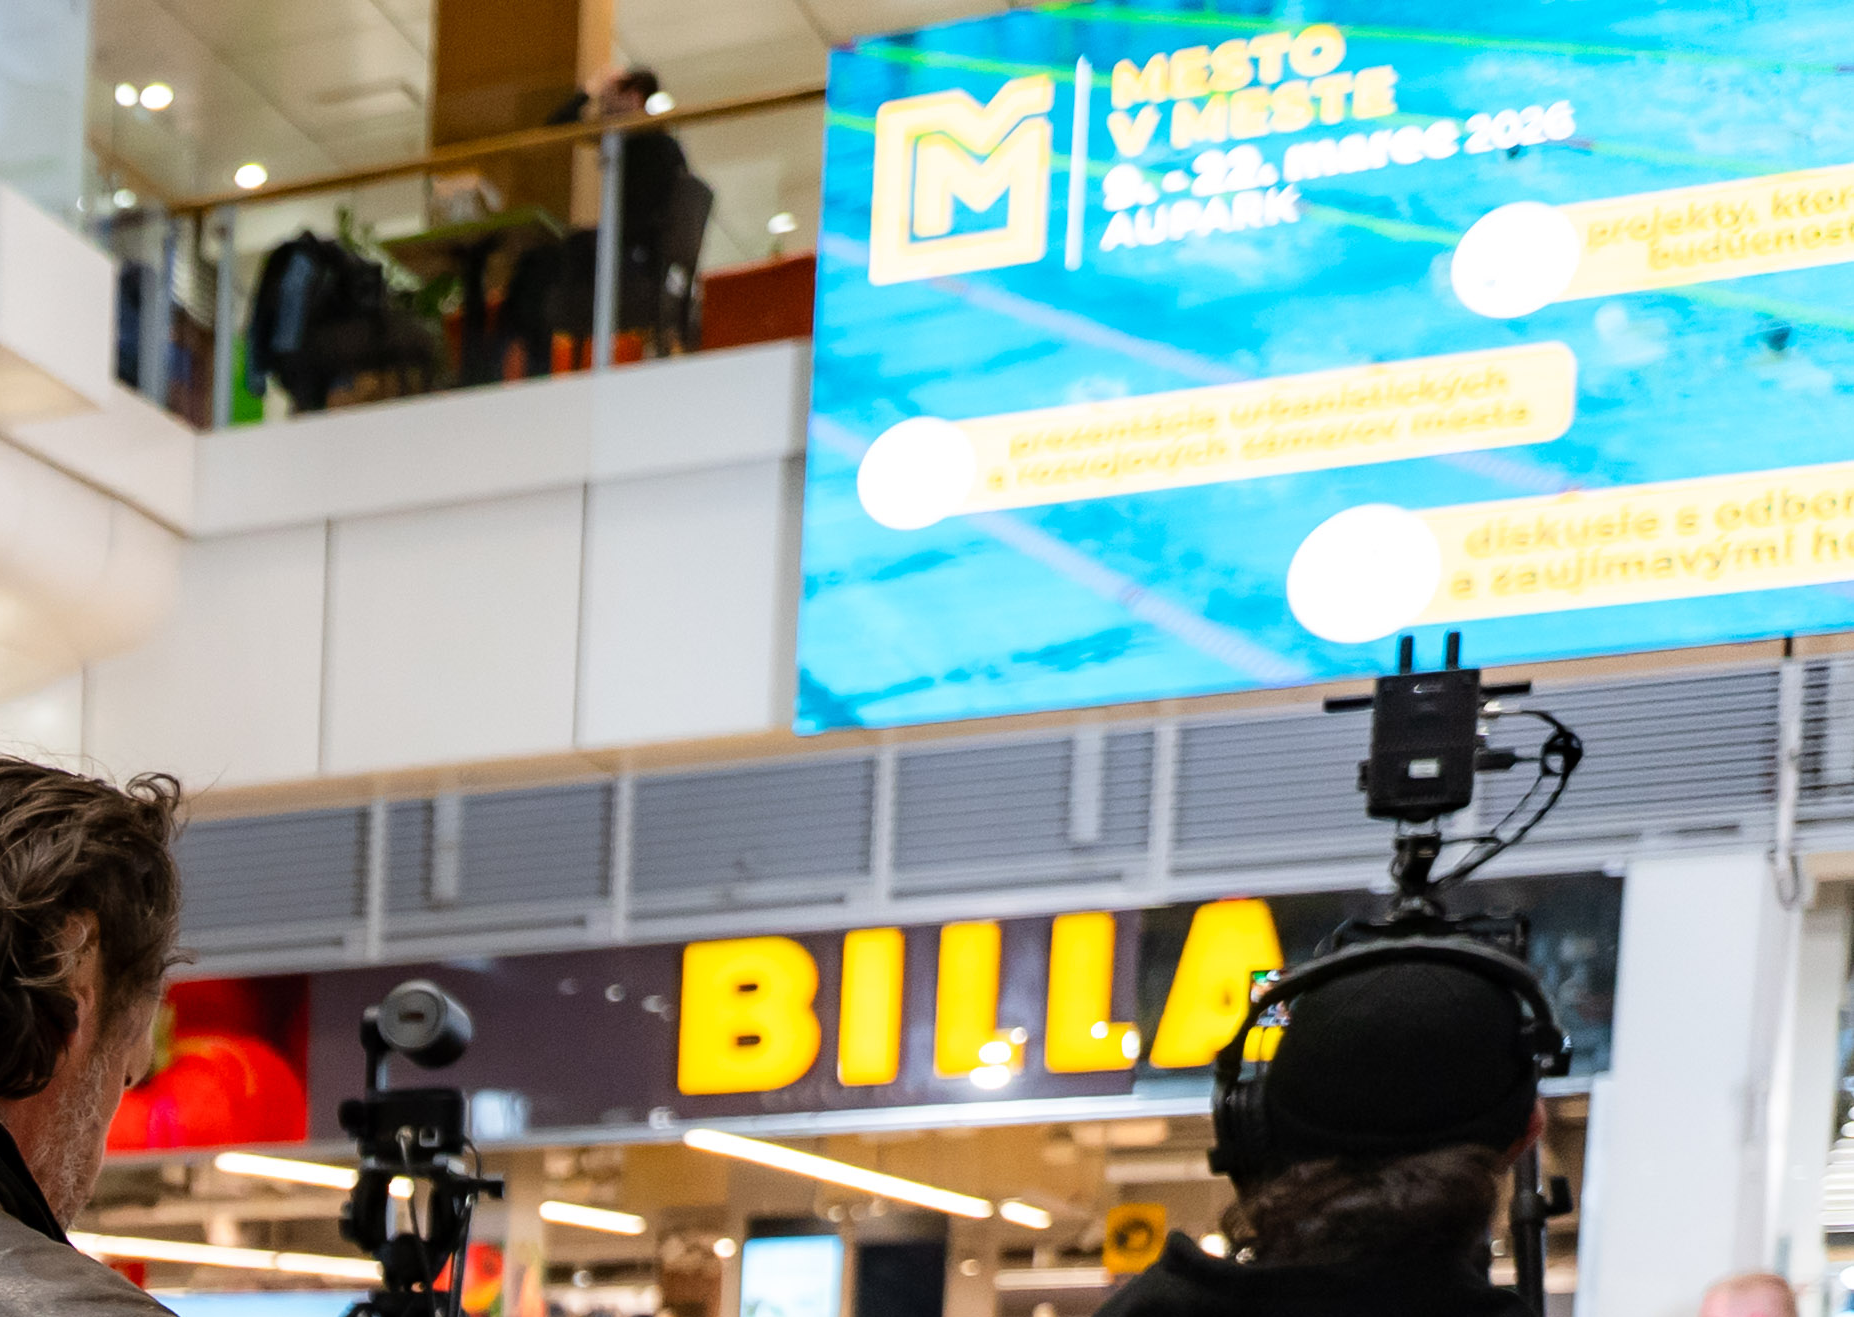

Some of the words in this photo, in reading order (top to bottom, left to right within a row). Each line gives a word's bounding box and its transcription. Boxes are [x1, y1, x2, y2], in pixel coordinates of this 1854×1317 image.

[1108, 103, 1162, 157] V
[1171, 65, 1397, 149] MESTE
[1111, 26, 1347, 109] MESTO
[1191, 144, 1278, 197] 22.
[1283, 118, 1460, 183] marec
[1463, 100, 1577, 158] 2026
[1100, 188, 1300, 251] AUPARK
[1464, 502, 1662, 558] diskusie
[678, 898, 1285, 1096] BILLA
